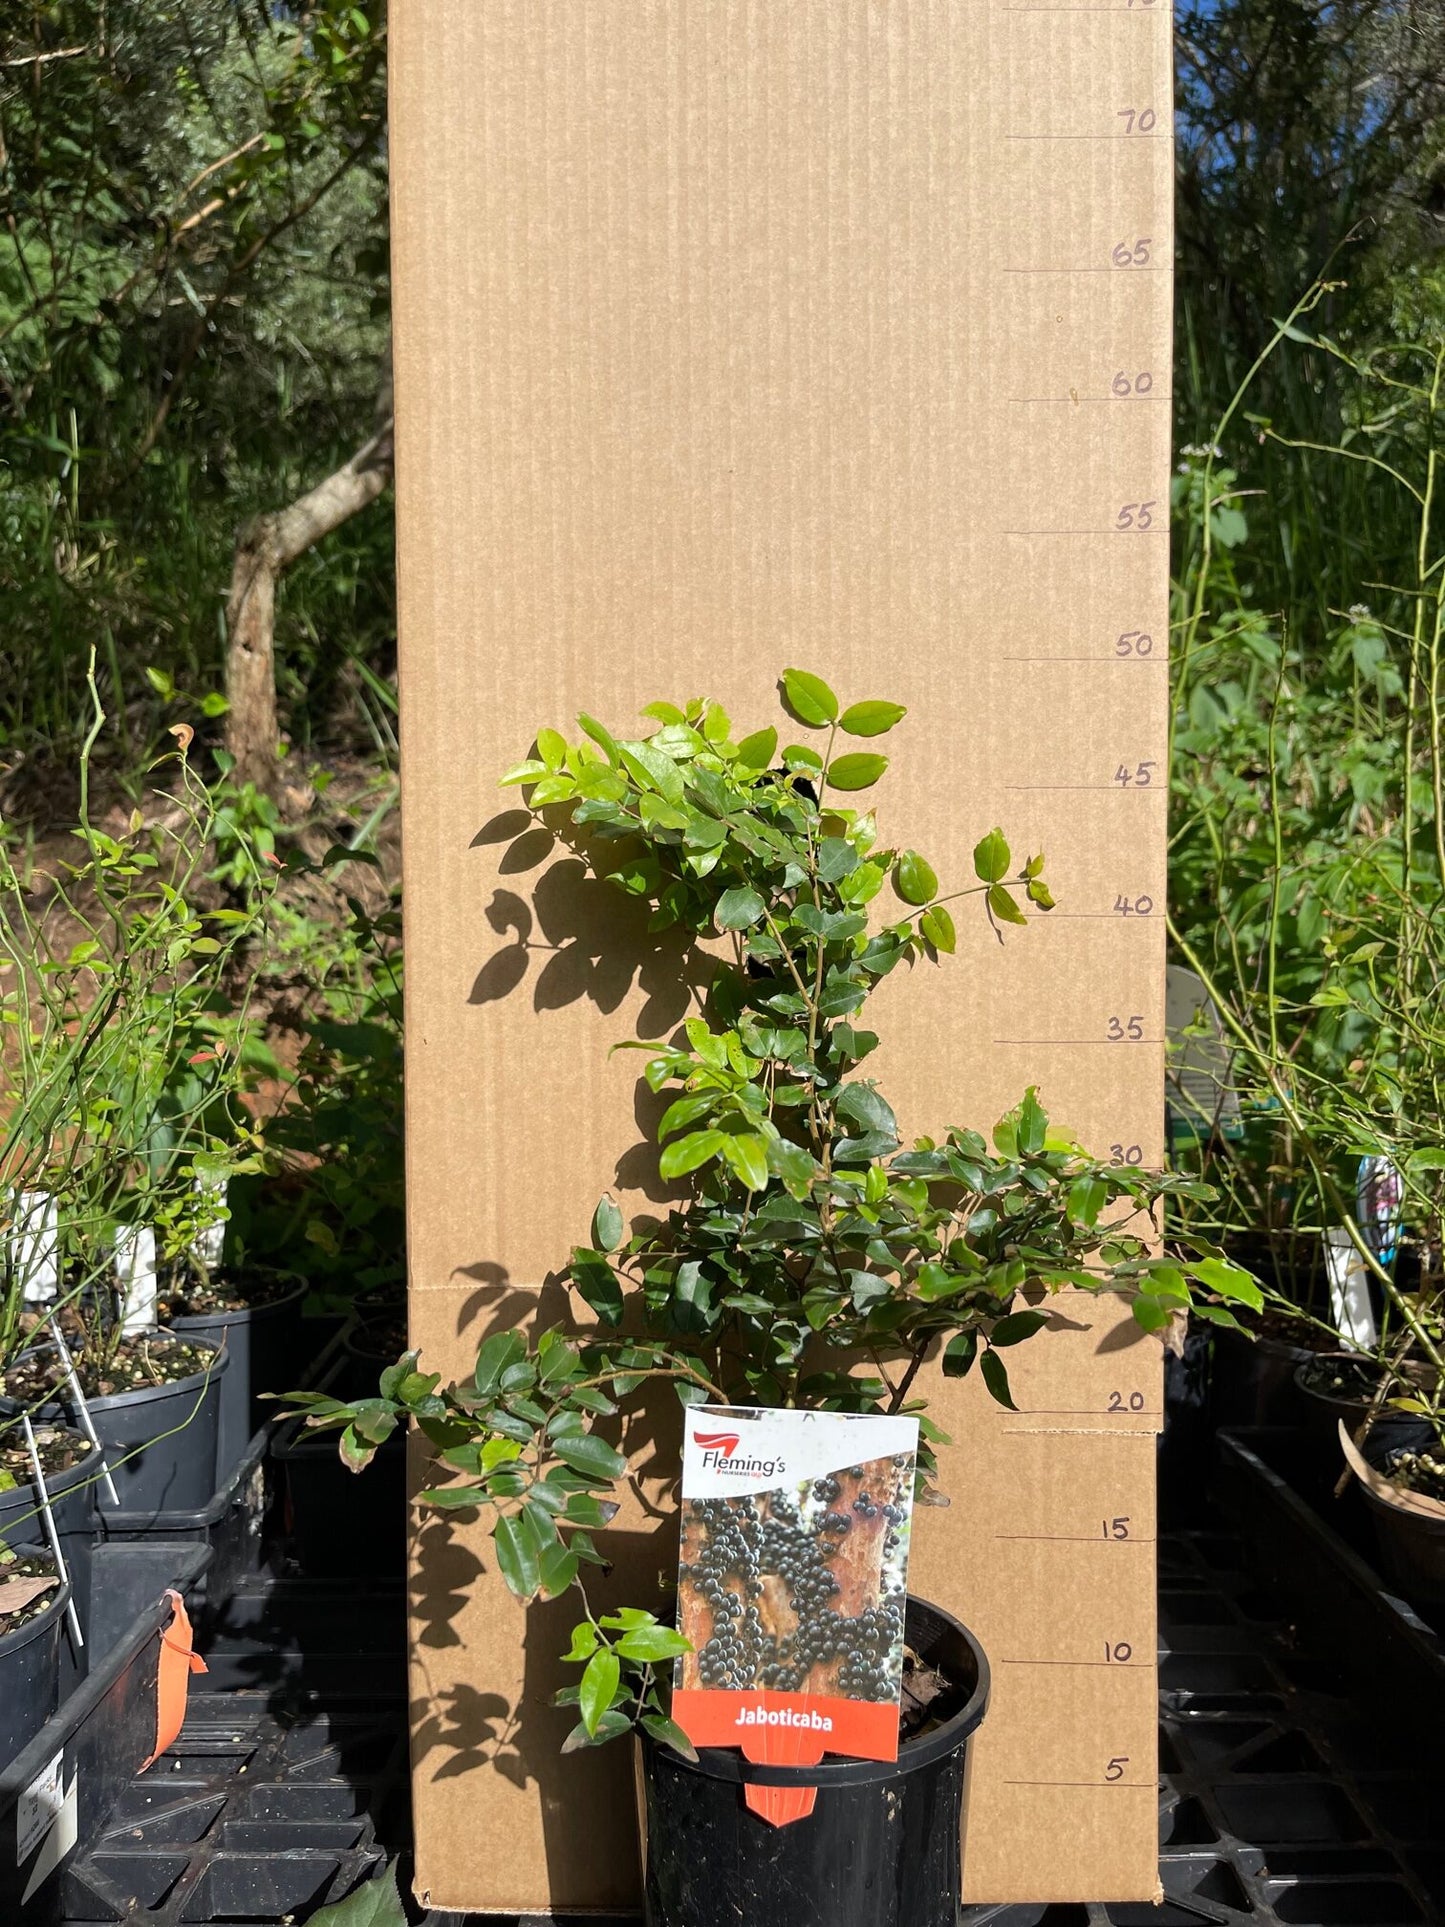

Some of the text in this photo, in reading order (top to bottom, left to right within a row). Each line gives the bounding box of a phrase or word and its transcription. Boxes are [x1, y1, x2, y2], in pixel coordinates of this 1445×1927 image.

[1117, 109, 1156, 134] 70
[1112, 239, 1152, 267] 65
[1113, 371, 1154, 397] 60
[1115, 501, 1157, 528] 55
[1115, 631, 1153, 657] 50
[1115, 762, 1157, 787] 45
[1113, 893, 1154, 916] 40
[1106, 1015, 1145, 1041] 35
[1109, 1143, 1143, 1167] 30
[1107, 1390, 1145, 1412] 20
[702, 1450, 786, 1477] Fleming's
[1102, 1516, 1131, 1540] 15
[1104, 1641, 1132, 1664] 10
[735, 1706, 833, 1732] Jaboticaba
[1104, 1757, 1130, 1781] 5
